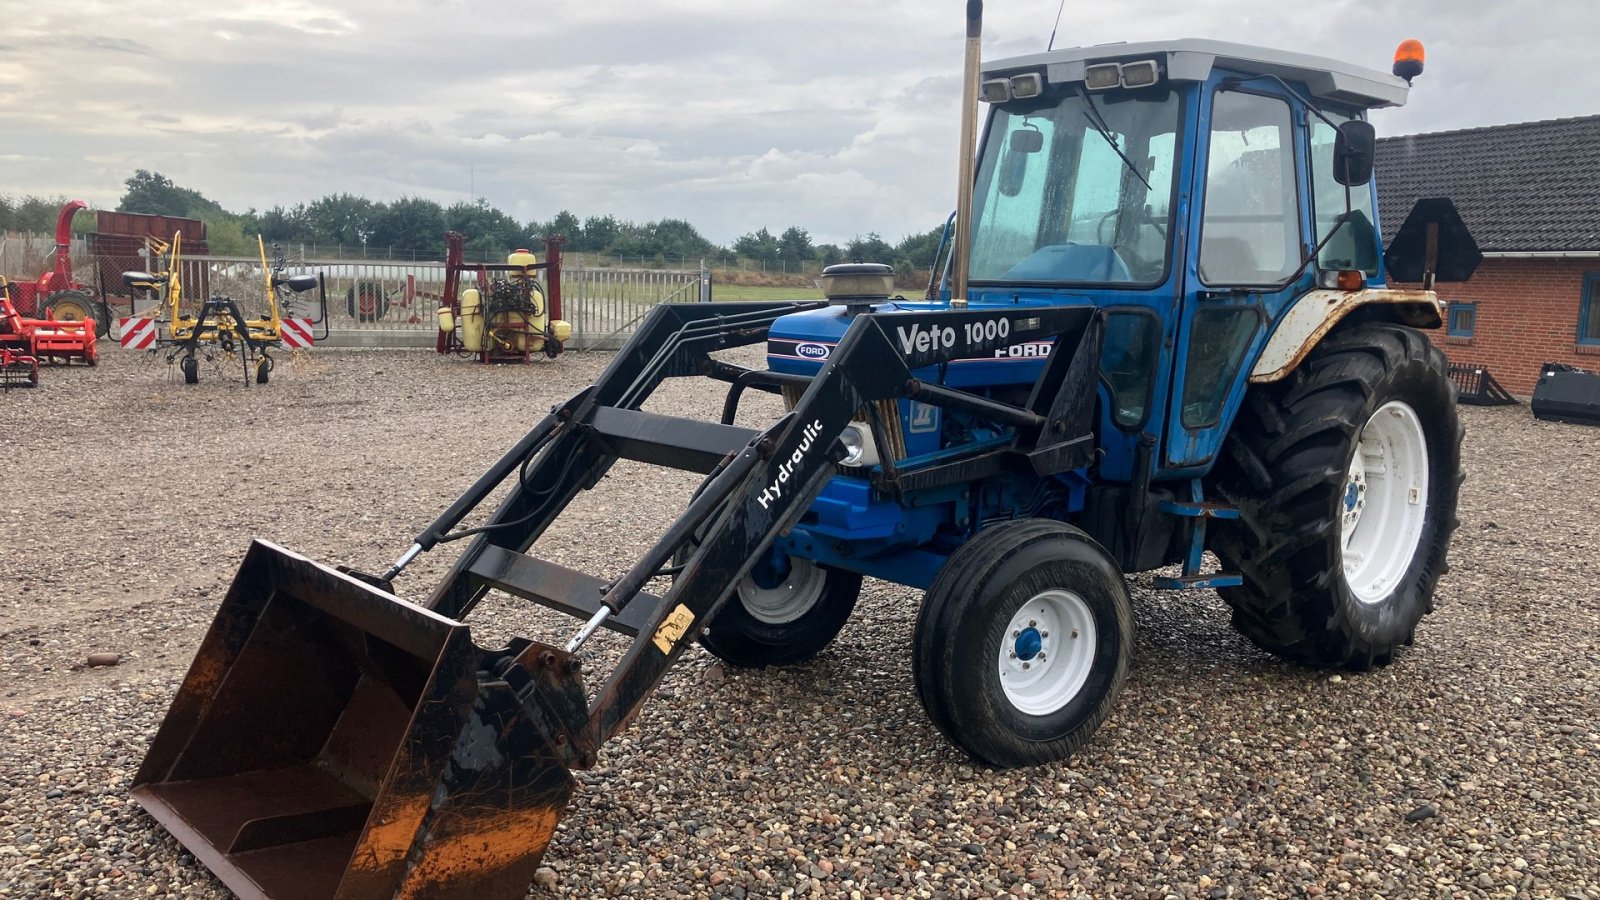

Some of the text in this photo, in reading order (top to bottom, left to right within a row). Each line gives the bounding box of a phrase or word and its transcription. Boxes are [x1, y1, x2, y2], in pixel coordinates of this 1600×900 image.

[897, 317, 1010, 355] Veto 1000
[800, 346, 824, 356] FORD
[994, 344, 1052, 358] FORD
[757, 419, 823, 510] Hydraulic
